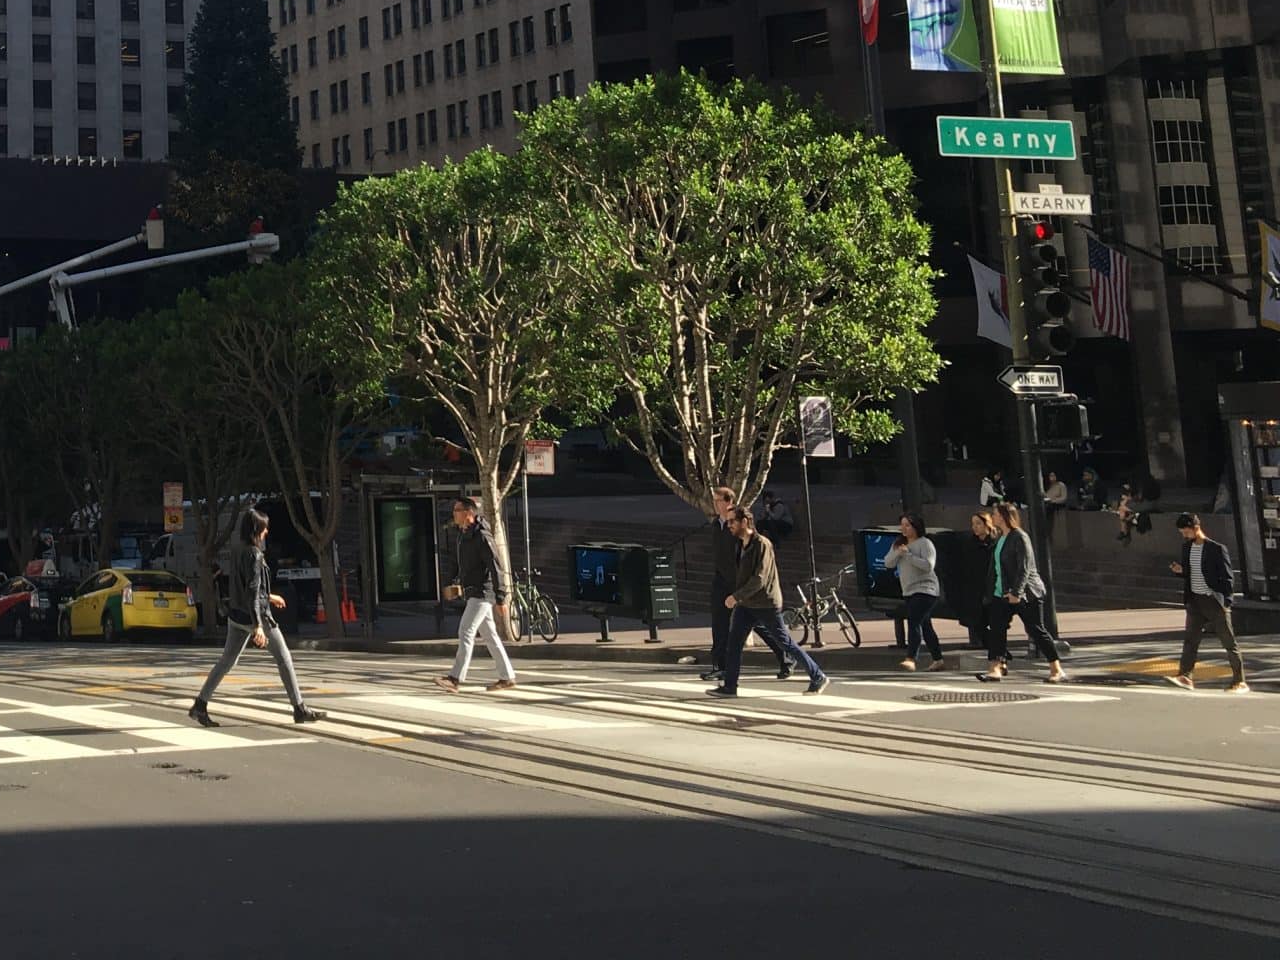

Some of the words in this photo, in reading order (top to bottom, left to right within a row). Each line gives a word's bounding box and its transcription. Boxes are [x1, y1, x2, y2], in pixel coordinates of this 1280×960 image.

[954, 126, 1056, 154] Kearny
[1020, 197, 1086, 211] KEARNY
[1017, 374, 1036, 385] ONE
[1038, 374, 1056, 385] WAY
